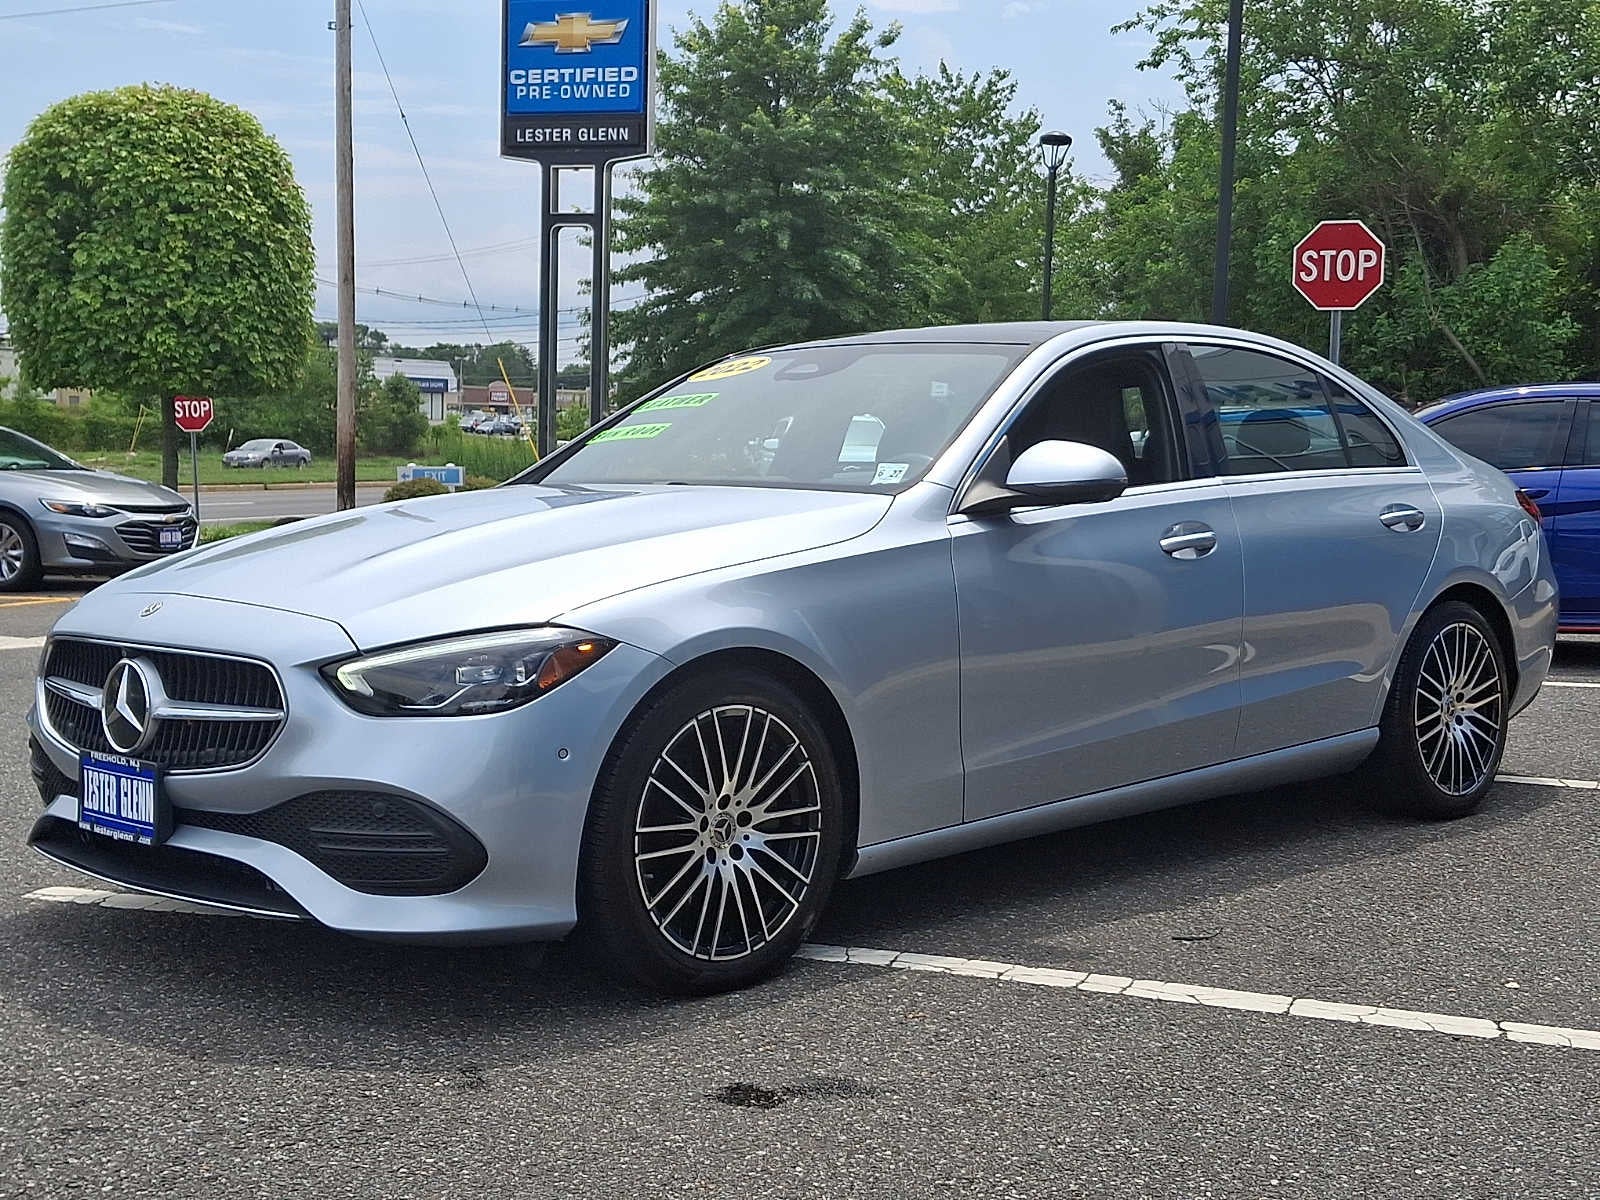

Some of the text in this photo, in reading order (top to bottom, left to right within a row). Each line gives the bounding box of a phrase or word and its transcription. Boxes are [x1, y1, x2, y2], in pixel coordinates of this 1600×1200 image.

[510, 67, 638, 84] CERTIFIED
[516, 84, 631, 99] PRE-OWNED
[516, 127, 629, 142] LESTER GLENN
[1299, 249, 1377, 282] STOP
[174, 400, 210, 418] STOP
[424, 470, 447, 481] EXIT
[83, 769, 154, 824] LESTER GLENN
